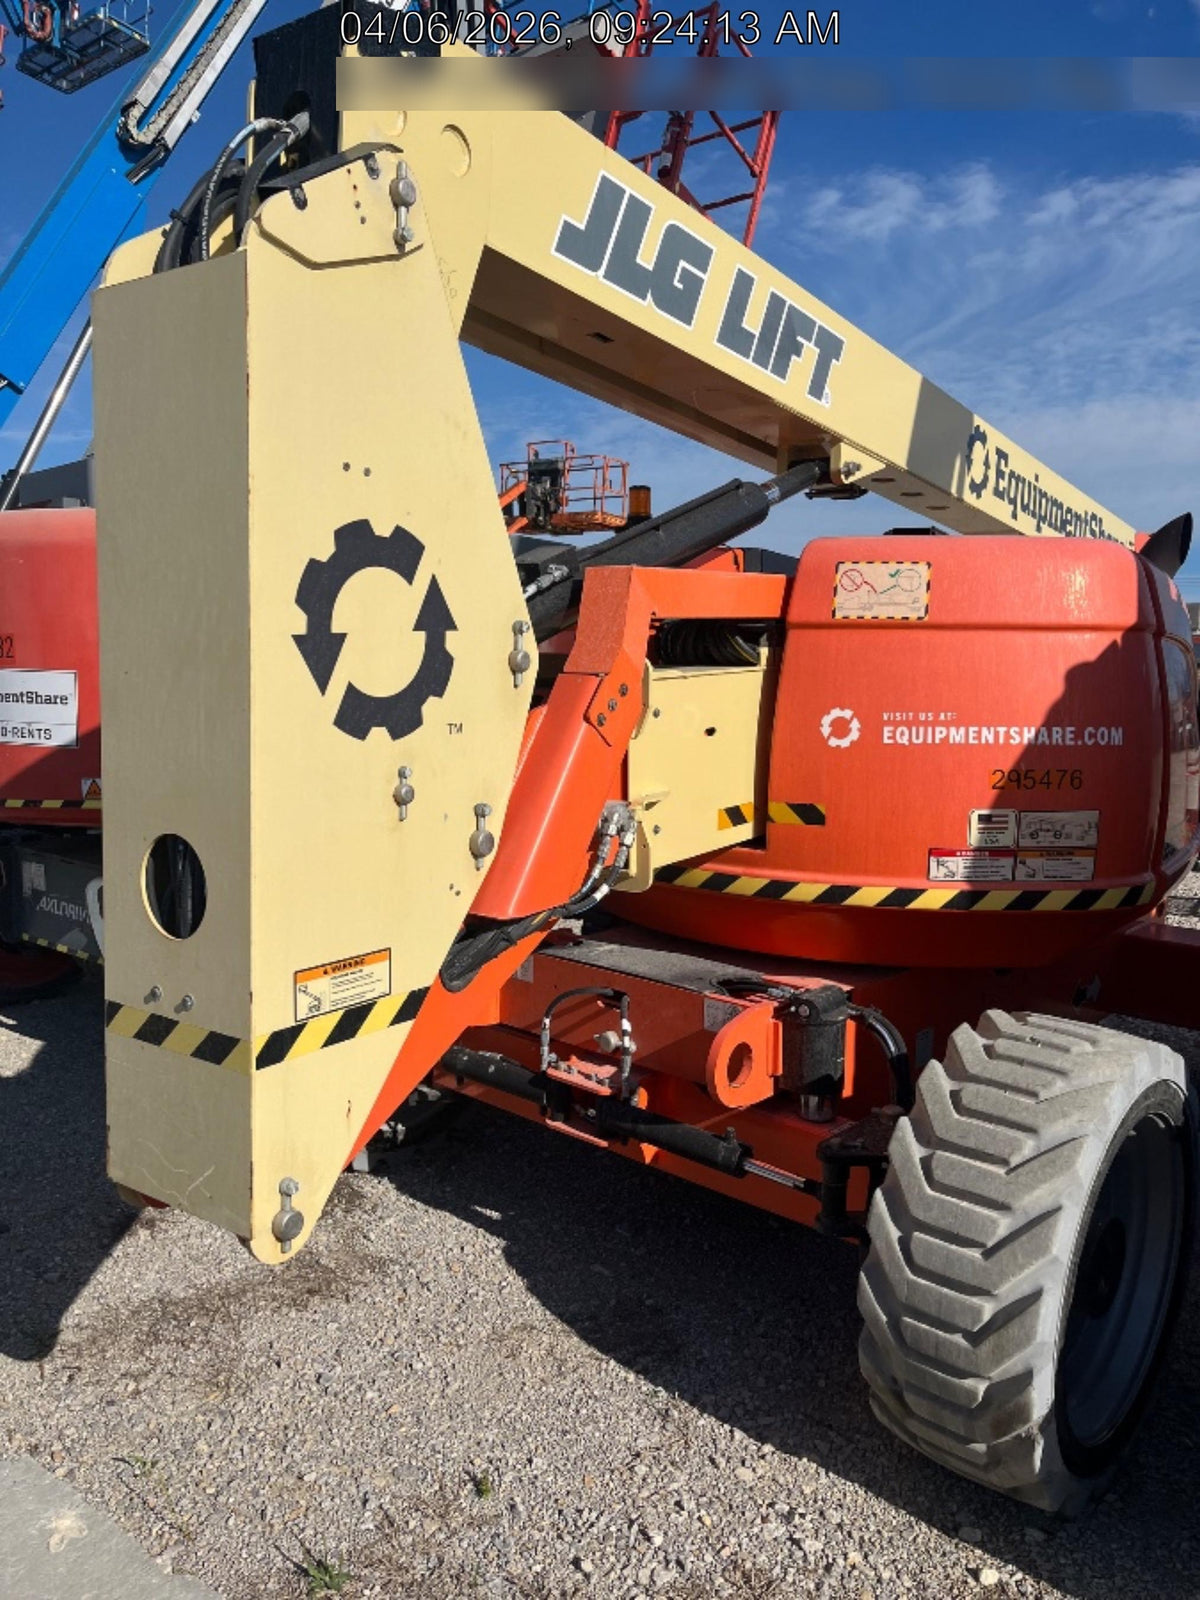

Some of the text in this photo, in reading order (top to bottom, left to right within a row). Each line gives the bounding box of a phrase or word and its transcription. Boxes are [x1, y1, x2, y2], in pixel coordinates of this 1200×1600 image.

[551, 169, 846, 406] JLG LIFT
[992, 445, 1125, 545] EquipmentSh
[882, 711, 957, 721] VISIT US AT:
[447, 722, 464, 735] TM
[882, 726, 1124, 746] EQUIPMENTSHARE.COM
[991, 769, 1083, 790] 295476
